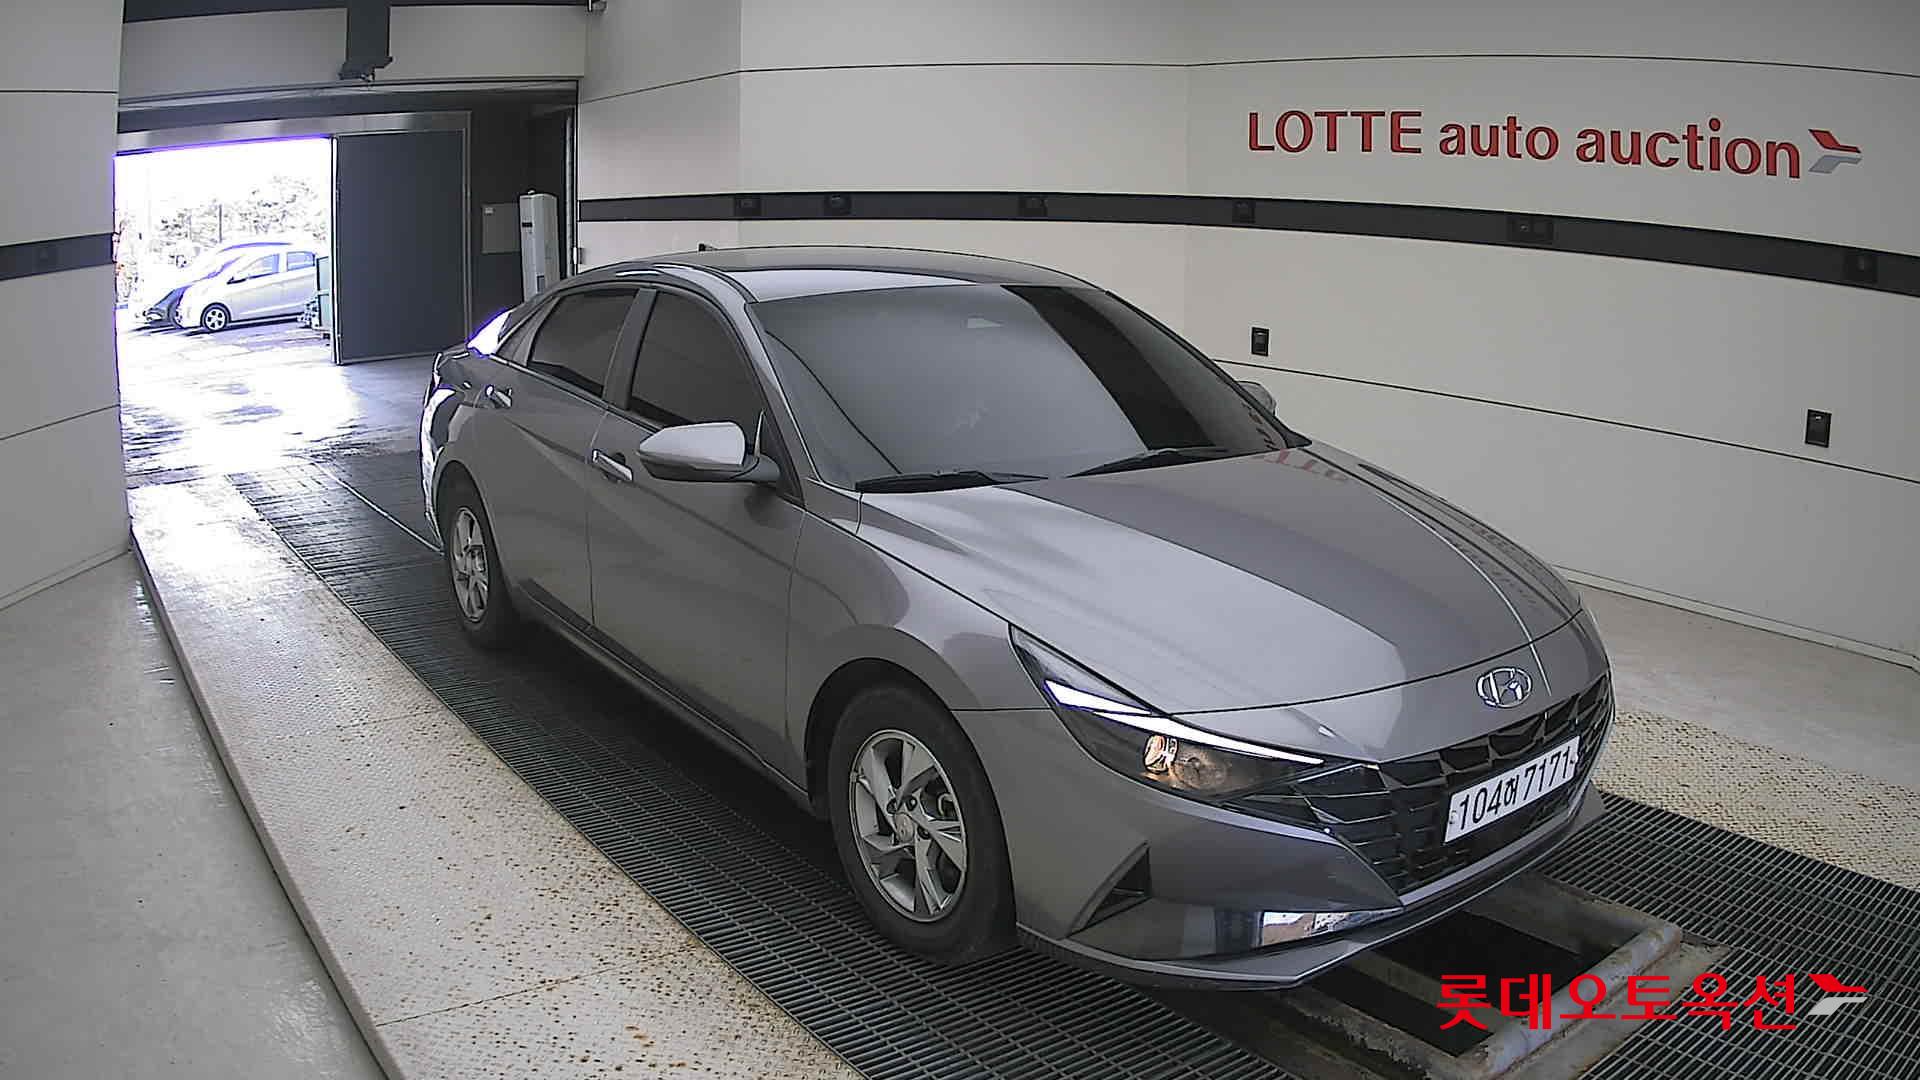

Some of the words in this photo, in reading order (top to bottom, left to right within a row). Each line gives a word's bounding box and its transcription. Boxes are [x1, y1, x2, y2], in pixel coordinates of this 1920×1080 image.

[1249, 111, 1422, 154] LOTTE
[1438, 116, 1559, 161] auto
[1575, 118, 1800, 179] auction
